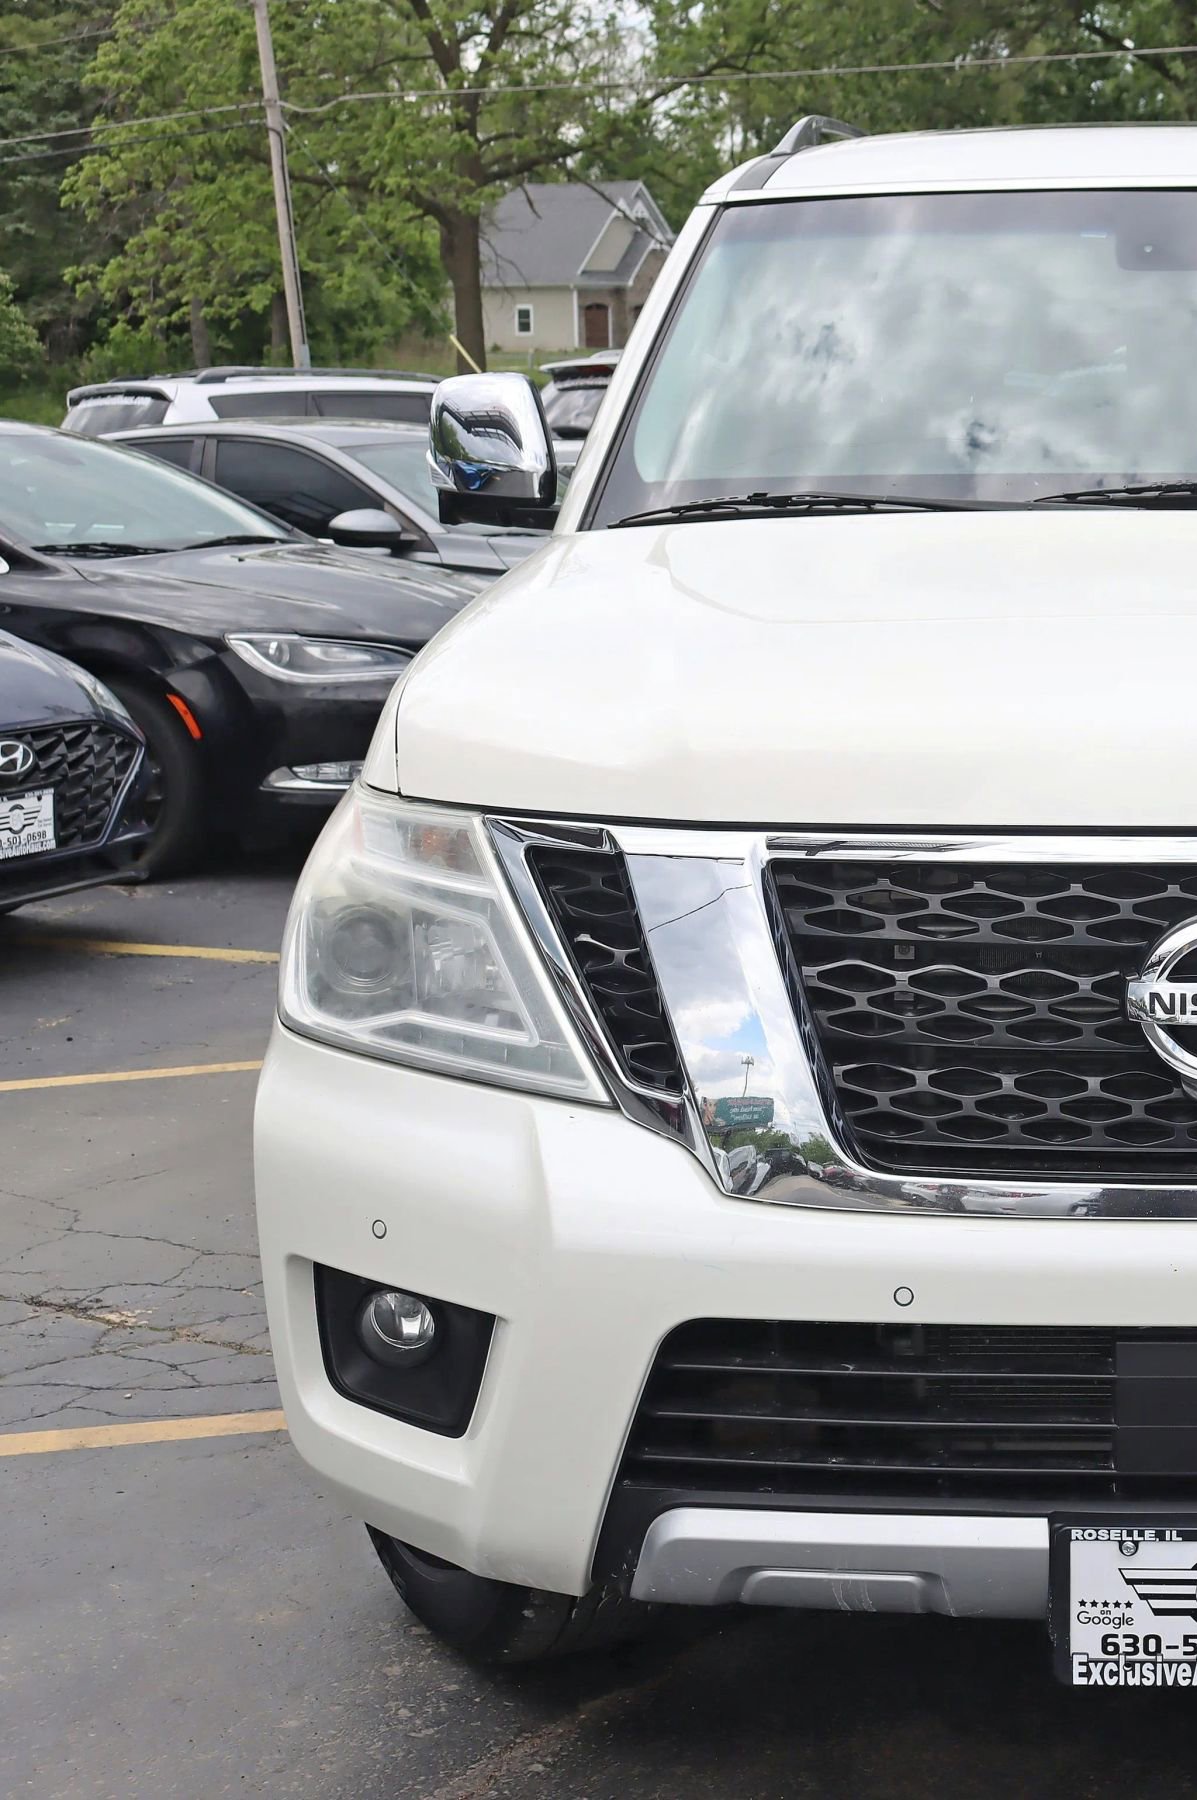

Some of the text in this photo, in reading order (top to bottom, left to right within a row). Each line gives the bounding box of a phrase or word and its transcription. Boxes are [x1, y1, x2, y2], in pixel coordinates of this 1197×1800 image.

[1070, 1529, 1183, 1542] ROSELLE, IL
[1077, 1611, 1134, 1629] Google
